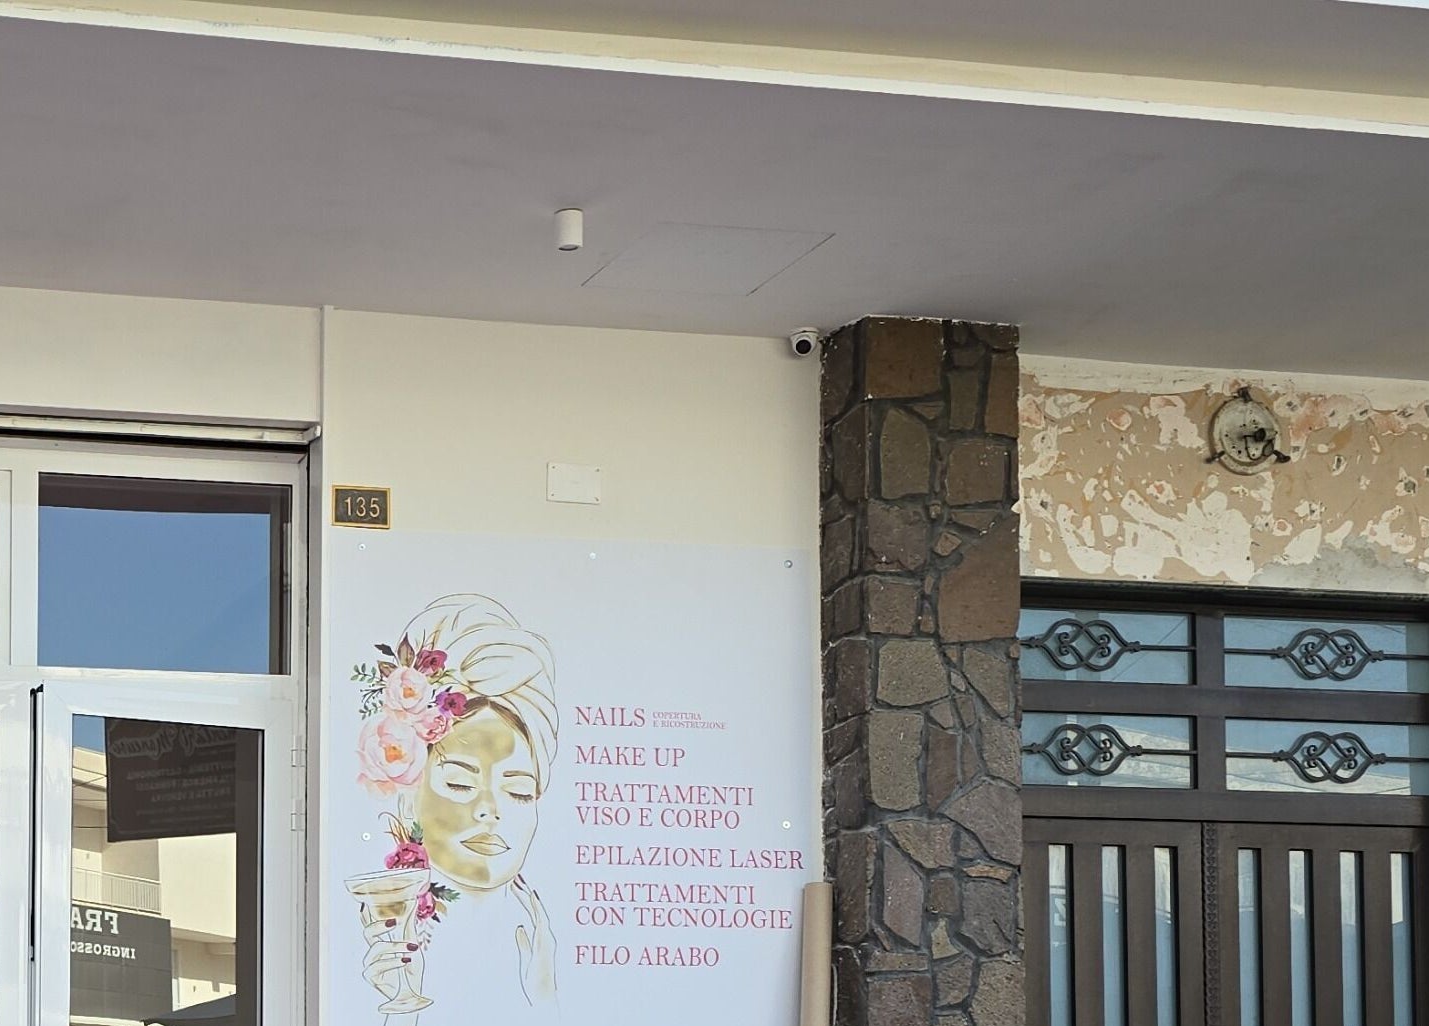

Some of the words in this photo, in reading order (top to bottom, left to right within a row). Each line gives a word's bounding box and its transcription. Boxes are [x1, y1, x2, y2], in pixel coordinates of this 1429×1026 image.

[344, 496, 380, 518] 135
[575, 706, 646, 728] NAILS
[652, 711, 702, 721] COPERTURA
[653, 720, 660, 728] E
[661, 720, 726, 730] RICOSTRUZIONE
[575, 745, 646, 767] MAKE
[654, 748, 686, 768] UP
[575, 782, 754, 806] TRATTAMENTI
[576, 806, 631, 826] VISO
[639, 808, 653, 827] E
[660, 808, 740, 829] CORPO
[576, 845, 722, 867] EPILAZIONE
[730, 849, 805, 870] LASER
[575, 882, 755, 905] TRATTAMENTI
[575, 905, 625, 926] CON
[633, 907, 794, 929] TECNOLOGIE
[575, 945, 631, 965] FILO
[638, 946, 720, 967] ARABO
